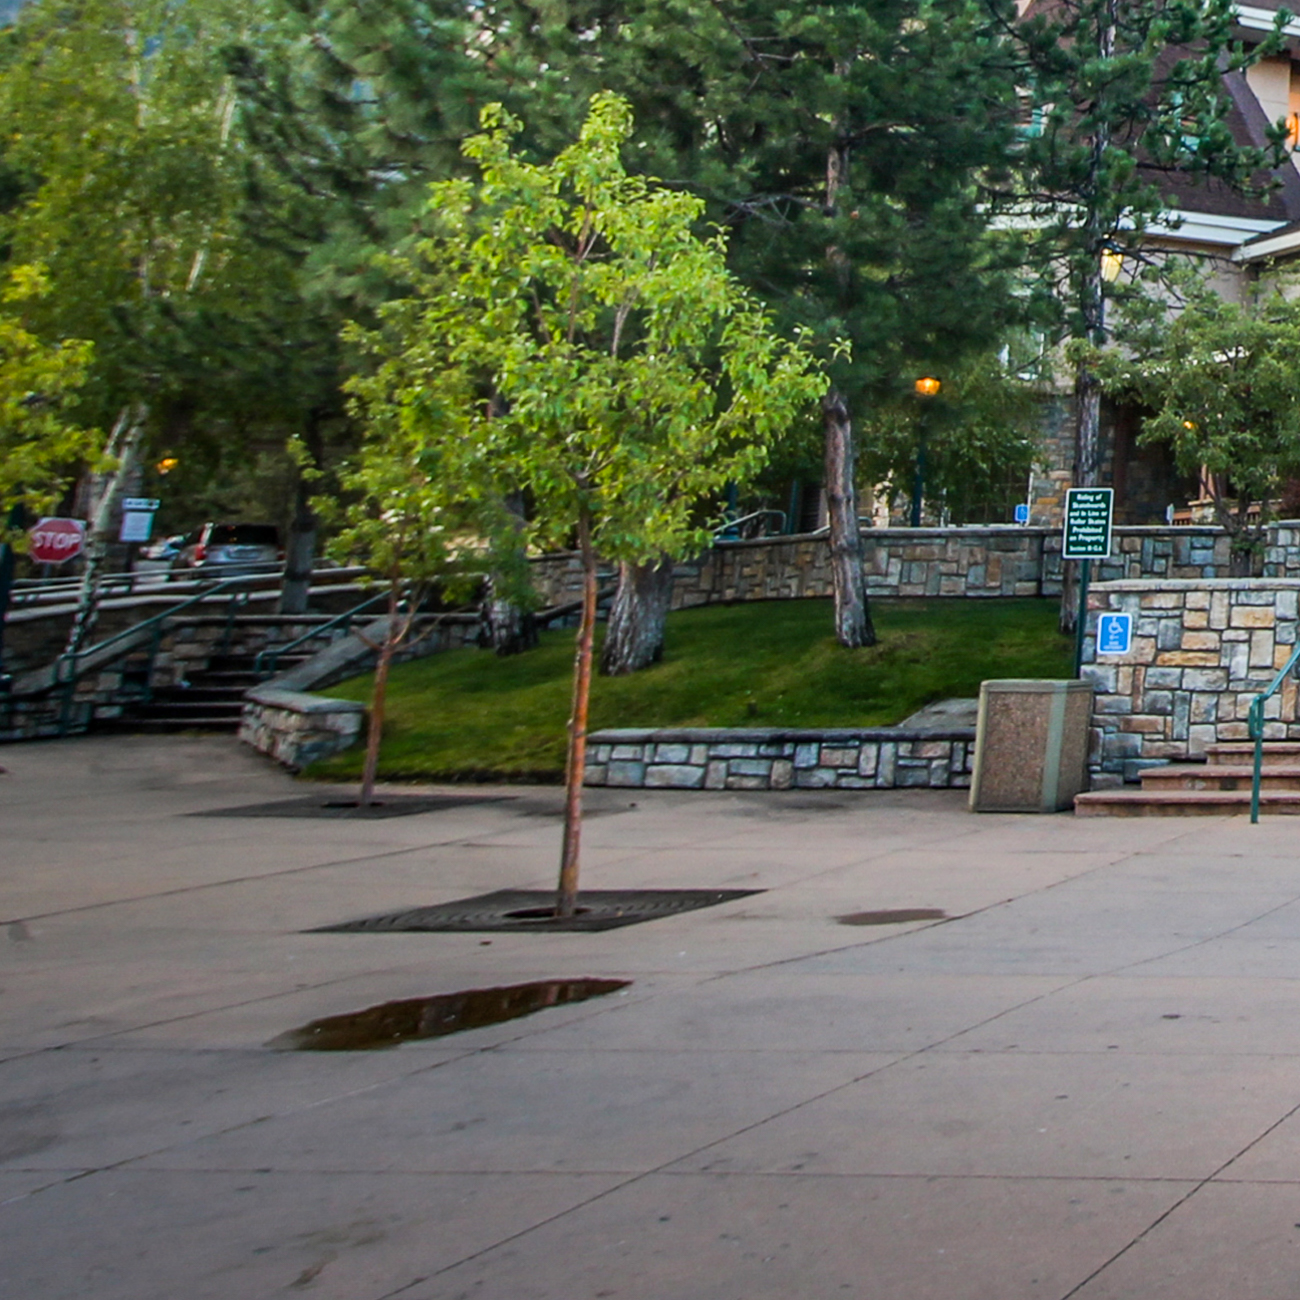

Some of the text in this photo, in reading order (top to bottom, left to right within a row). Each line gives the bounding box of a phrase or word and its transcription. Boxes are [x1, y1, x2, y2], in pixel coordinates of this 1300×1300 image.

[1072, 501, 1106, 509] Skateboards
[33, 531, 82, 550] STOP
[1078, 533, 1105, 543] Property
